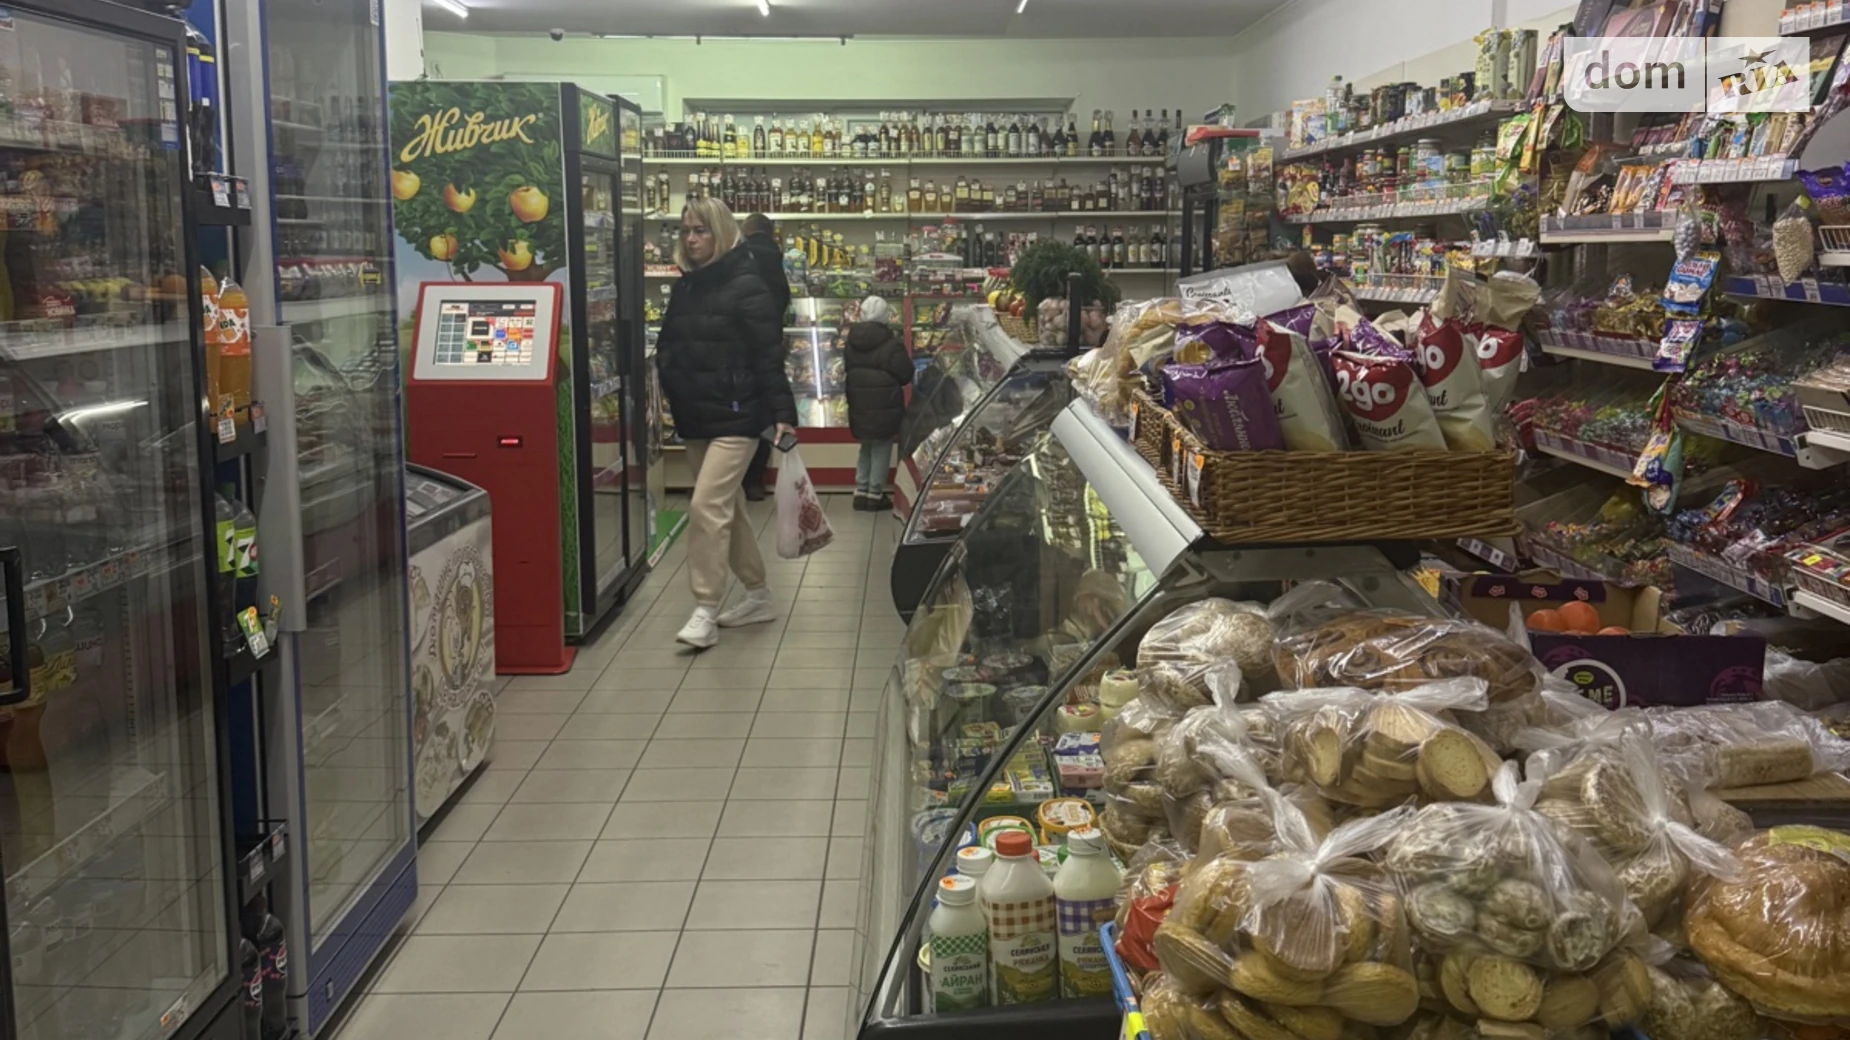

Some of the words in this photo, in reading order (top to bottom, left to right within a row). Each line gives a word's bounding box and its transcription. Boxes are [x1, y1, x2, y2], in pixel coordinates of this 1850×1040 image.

[400, 106, 536, 163] Живчик
[1336, 369, 1396, 411] 2go
[941, 971, 983, 988] АЙРАН
